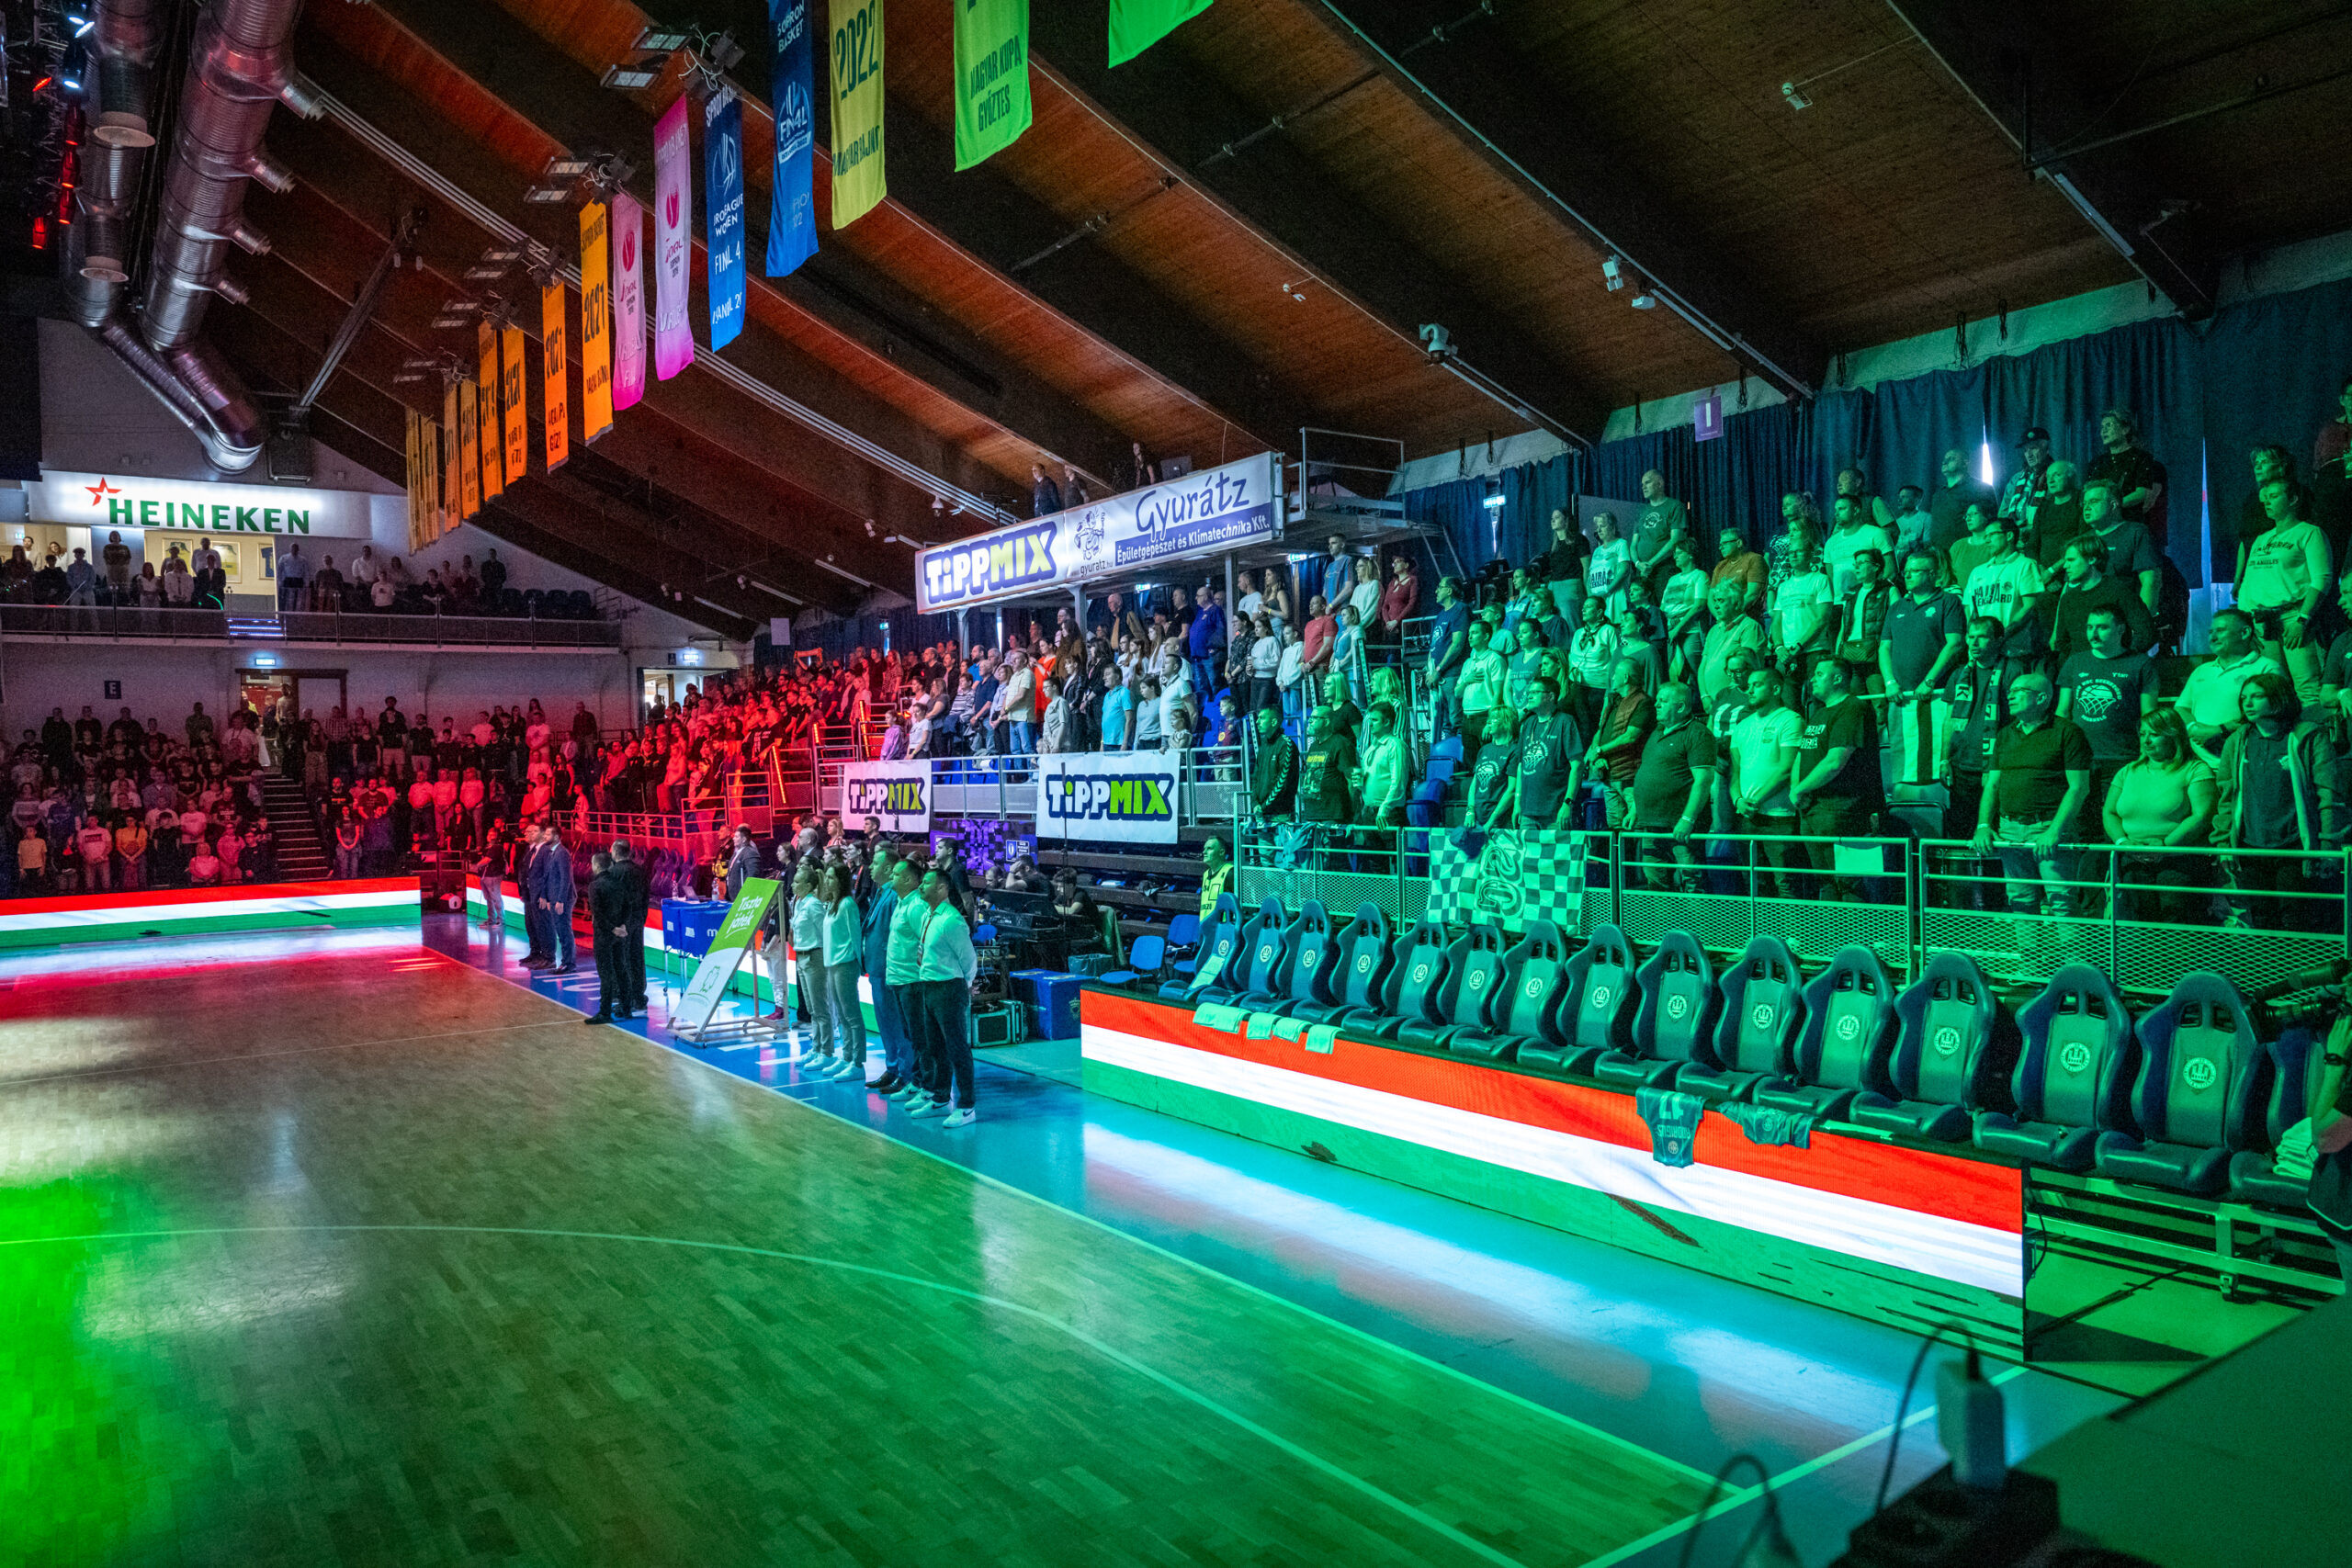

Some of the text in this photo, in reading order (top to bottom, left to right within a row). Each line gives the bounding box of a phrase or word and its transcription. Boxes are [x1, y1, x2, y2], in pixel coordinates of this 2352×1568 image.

[778, 18, 804, 53] BASKET
[836, 0, 879, 103] 2022
[1000, 35, 1023, 81] KUPA
[108, 498, 310, 535] HEINEKEN
[1136, 471, 1250, 543] Gyurátz
[1177, 534, 1187, 548] és
[1251, 515, 1270, 531] Kft.
[726, 910, 754, 934] játék
[738, 896, 763, 912] Tiszta
